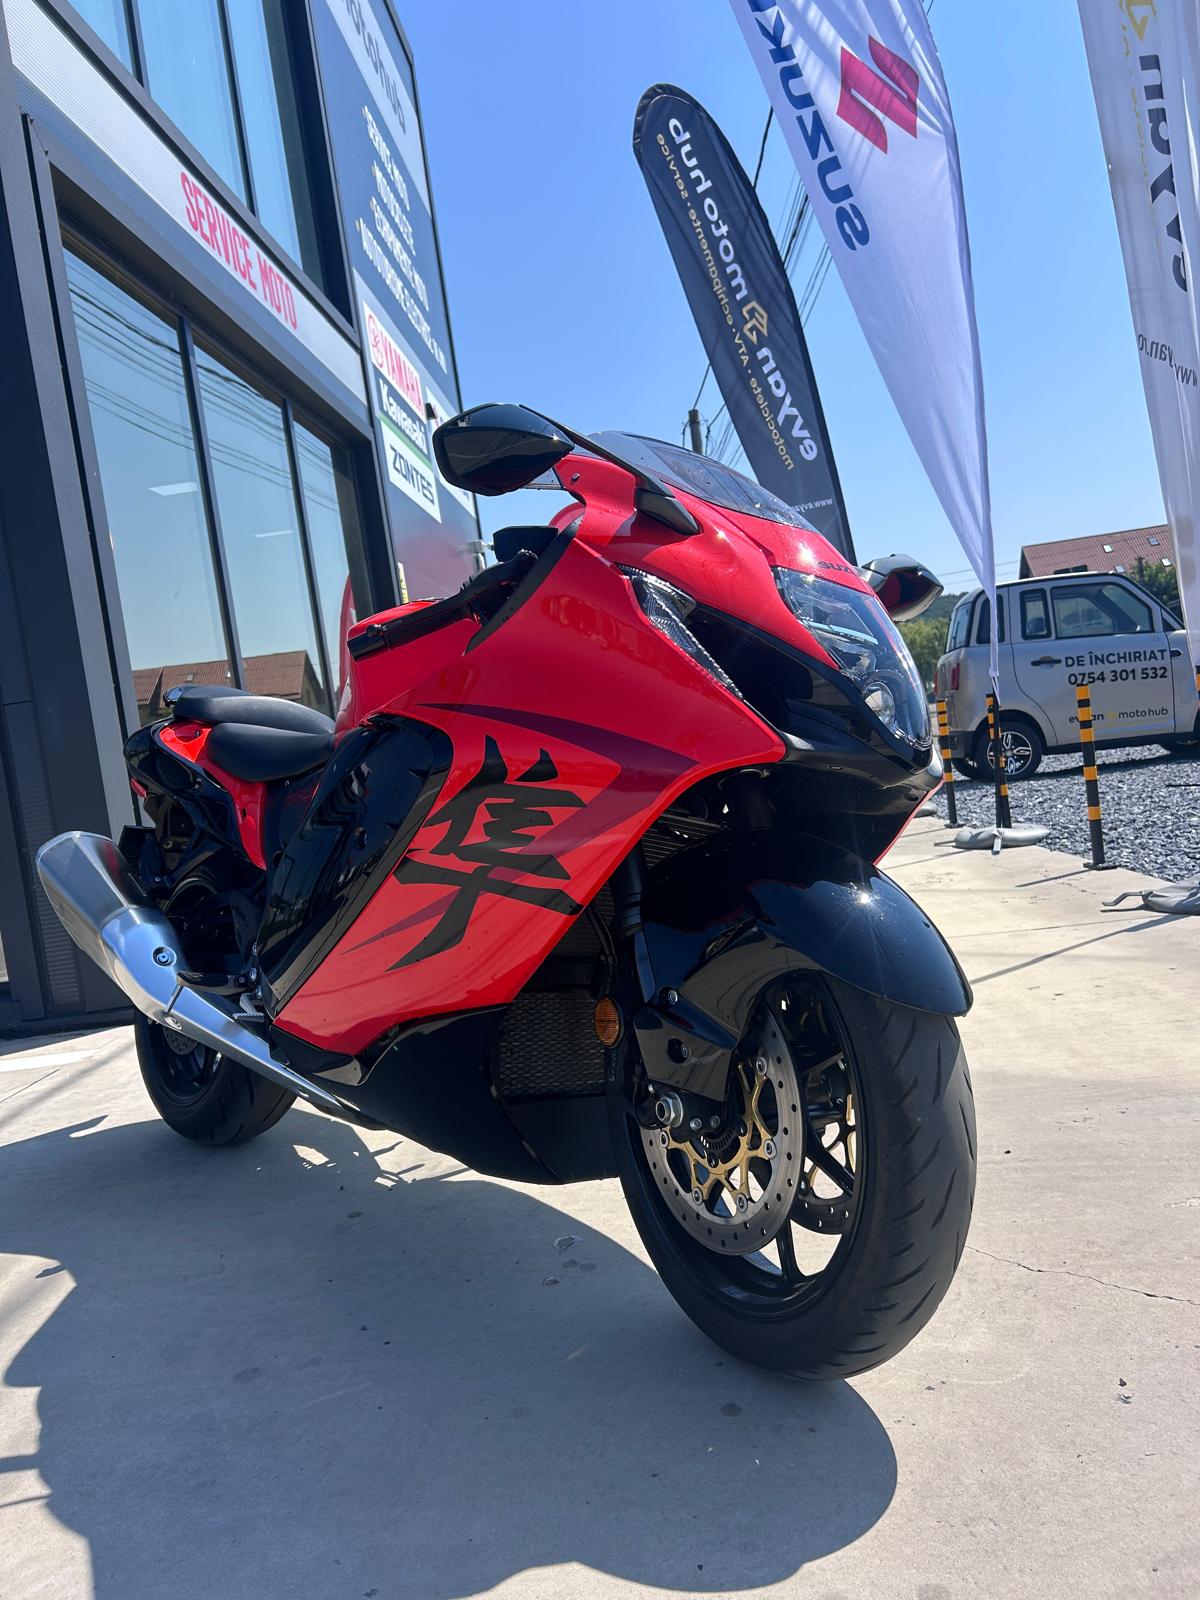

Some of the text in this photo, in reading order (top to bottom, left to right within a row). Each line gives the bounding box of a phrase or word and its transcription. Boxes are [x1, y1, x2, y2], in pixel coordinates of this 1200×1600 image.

[342, 0, 379, 75] oto
[180, 171, 298, 330] SERVICE MOTO
[379, 329, 425, 420] YAMAHA
[379, 378, 428, 455] Kawasaki
[389, 444, 435, 505] ZONTES
[1064, 649, 1167, 668] DE ÎNCHIRIAT
[1068, 666, 1168, 685] 0754 301 532
[1118, 708, 1147, 719] moto
[1148, 706, 1169, 716] hub
[384, 733, 588, 973] 隼
